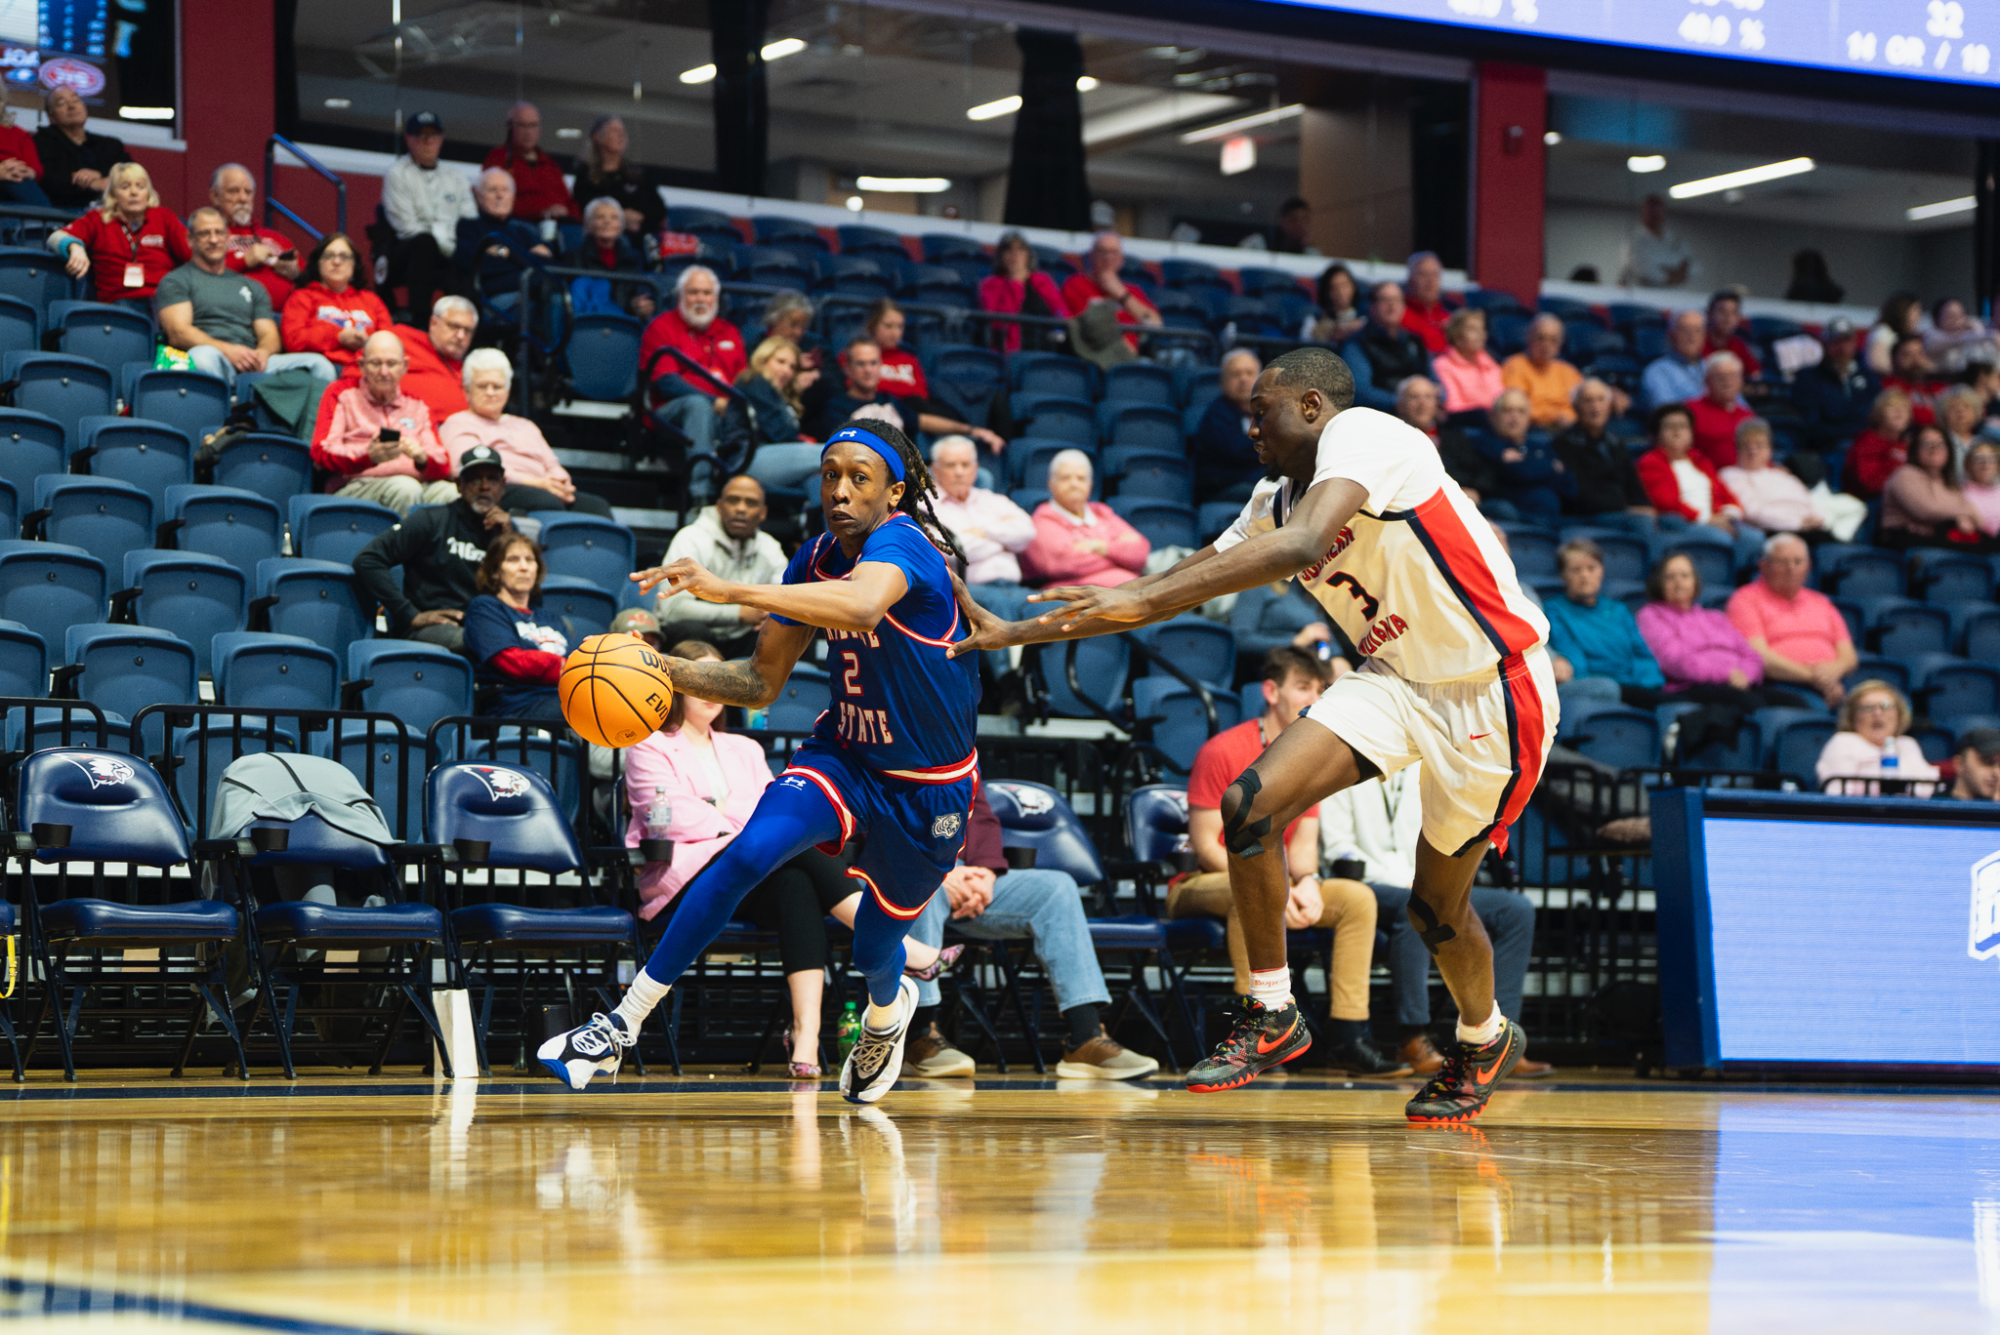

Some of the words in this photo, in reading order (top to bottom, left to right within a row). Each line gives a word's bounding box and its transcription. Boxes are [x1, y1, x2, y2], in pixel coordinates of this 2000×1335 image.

[1739, 18, 1766, 50] %
[1926, 0, 1964, 39] 32
[1934, 40, 1952, 69] /
[1301, 525, 1355, 581] SOERN
[1325, 571, 1379, 622] 3
[1357, 613, 1409, 655] DIANA
[840, 650, 864, 696] 2
[837, 701, 894, 744] STATE
